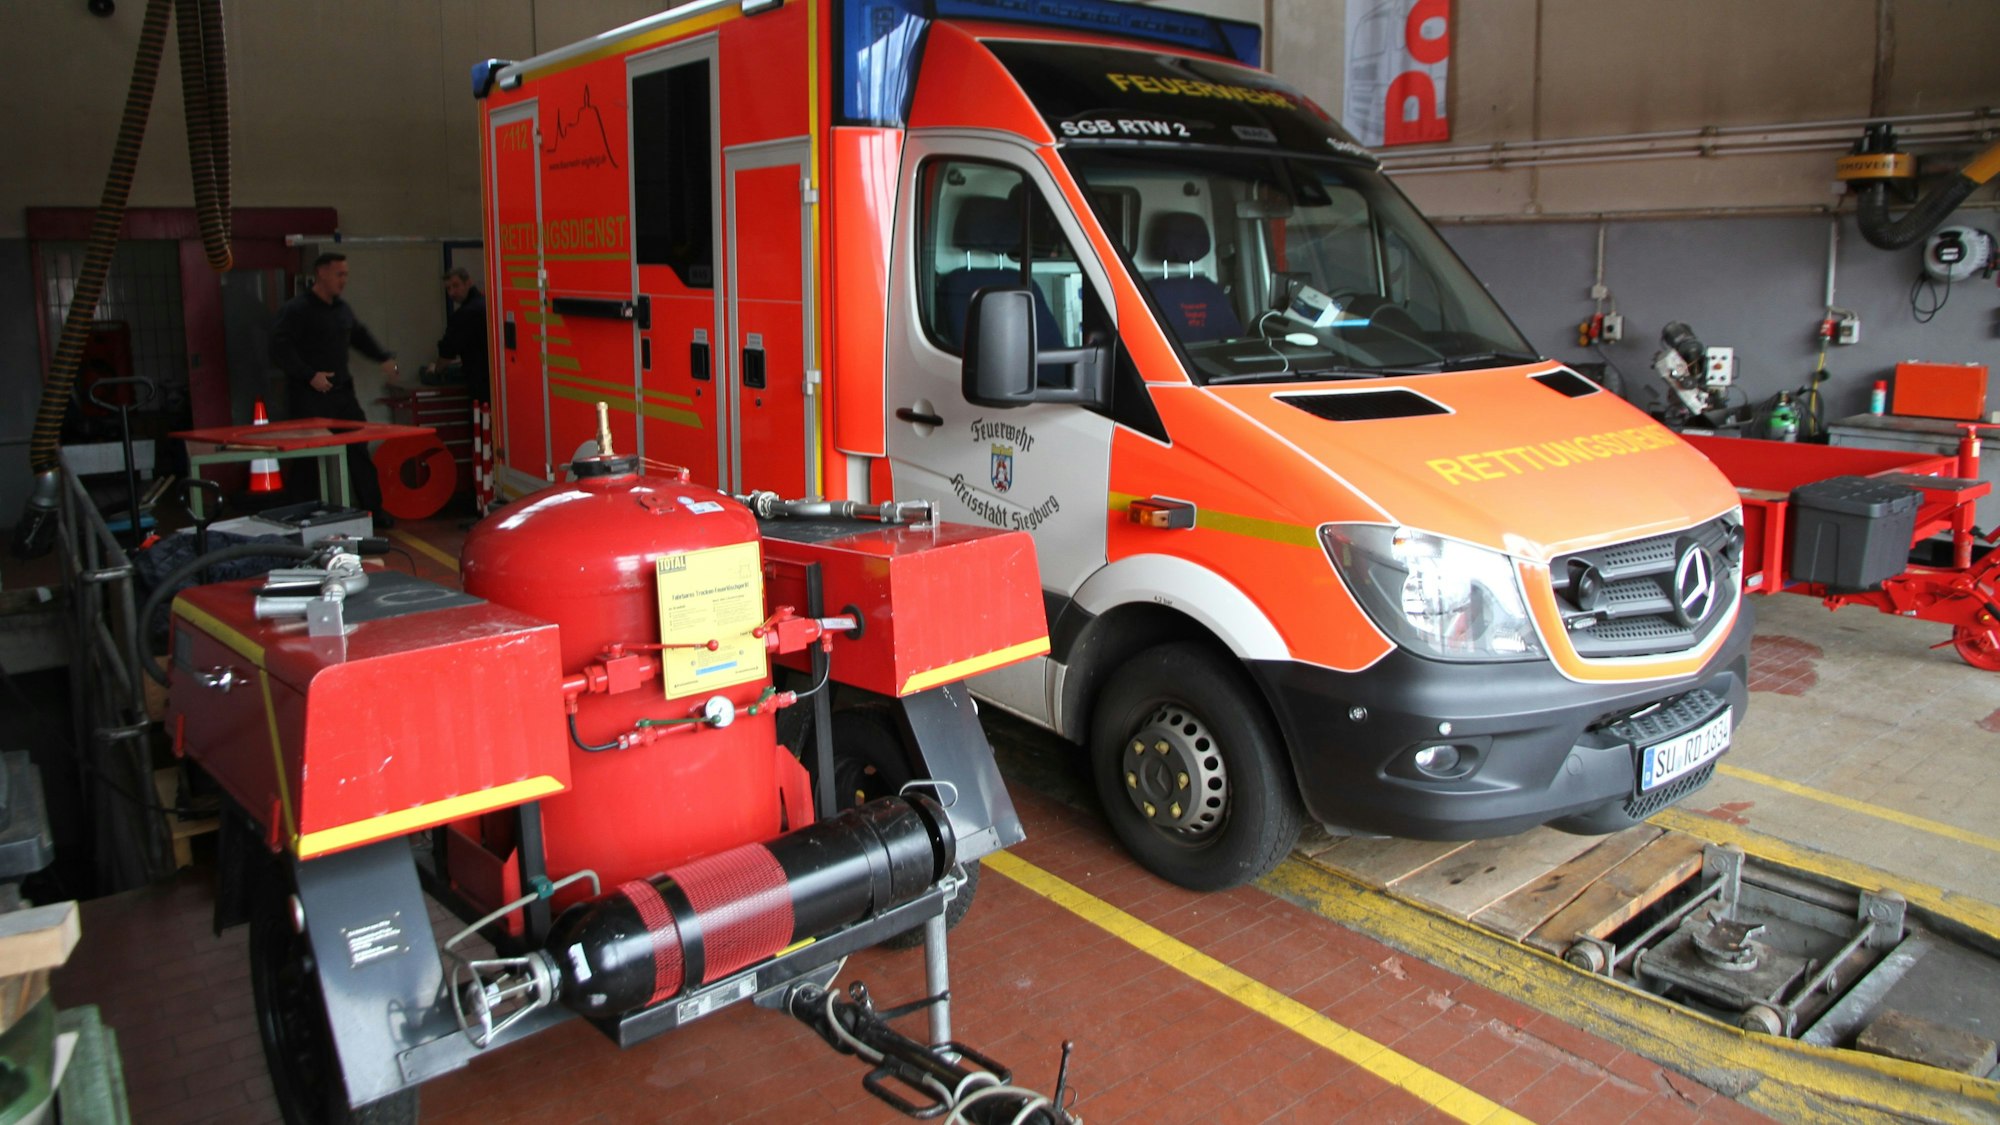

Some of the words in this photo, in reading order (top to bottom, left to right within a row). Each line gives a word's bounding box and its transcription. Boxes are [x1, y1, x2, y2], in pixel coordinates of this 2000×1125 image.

[1107, 73, 1296, 110] FEUERWEHR
[1060, 119, 1116, 136] SGB
[1117, 119, 1171, 136] RTW
[1172, 122, 1191, 138] 2
[501, 215, 627, 250] RETTUNGSDIENST
[971, 417, 1035, 452] Feuerwehr
[1425, 424, 1678, 486] RETTUNGSDIENS
[949, 473, 1008, 528] Kreisstadt
[1012, 495, 1060, 531] Siegburg
[659, 555, 686, 572] TOTAL
[1656, 746, 1677, 778] SU
[1684, 734, 1702, 766] RD
